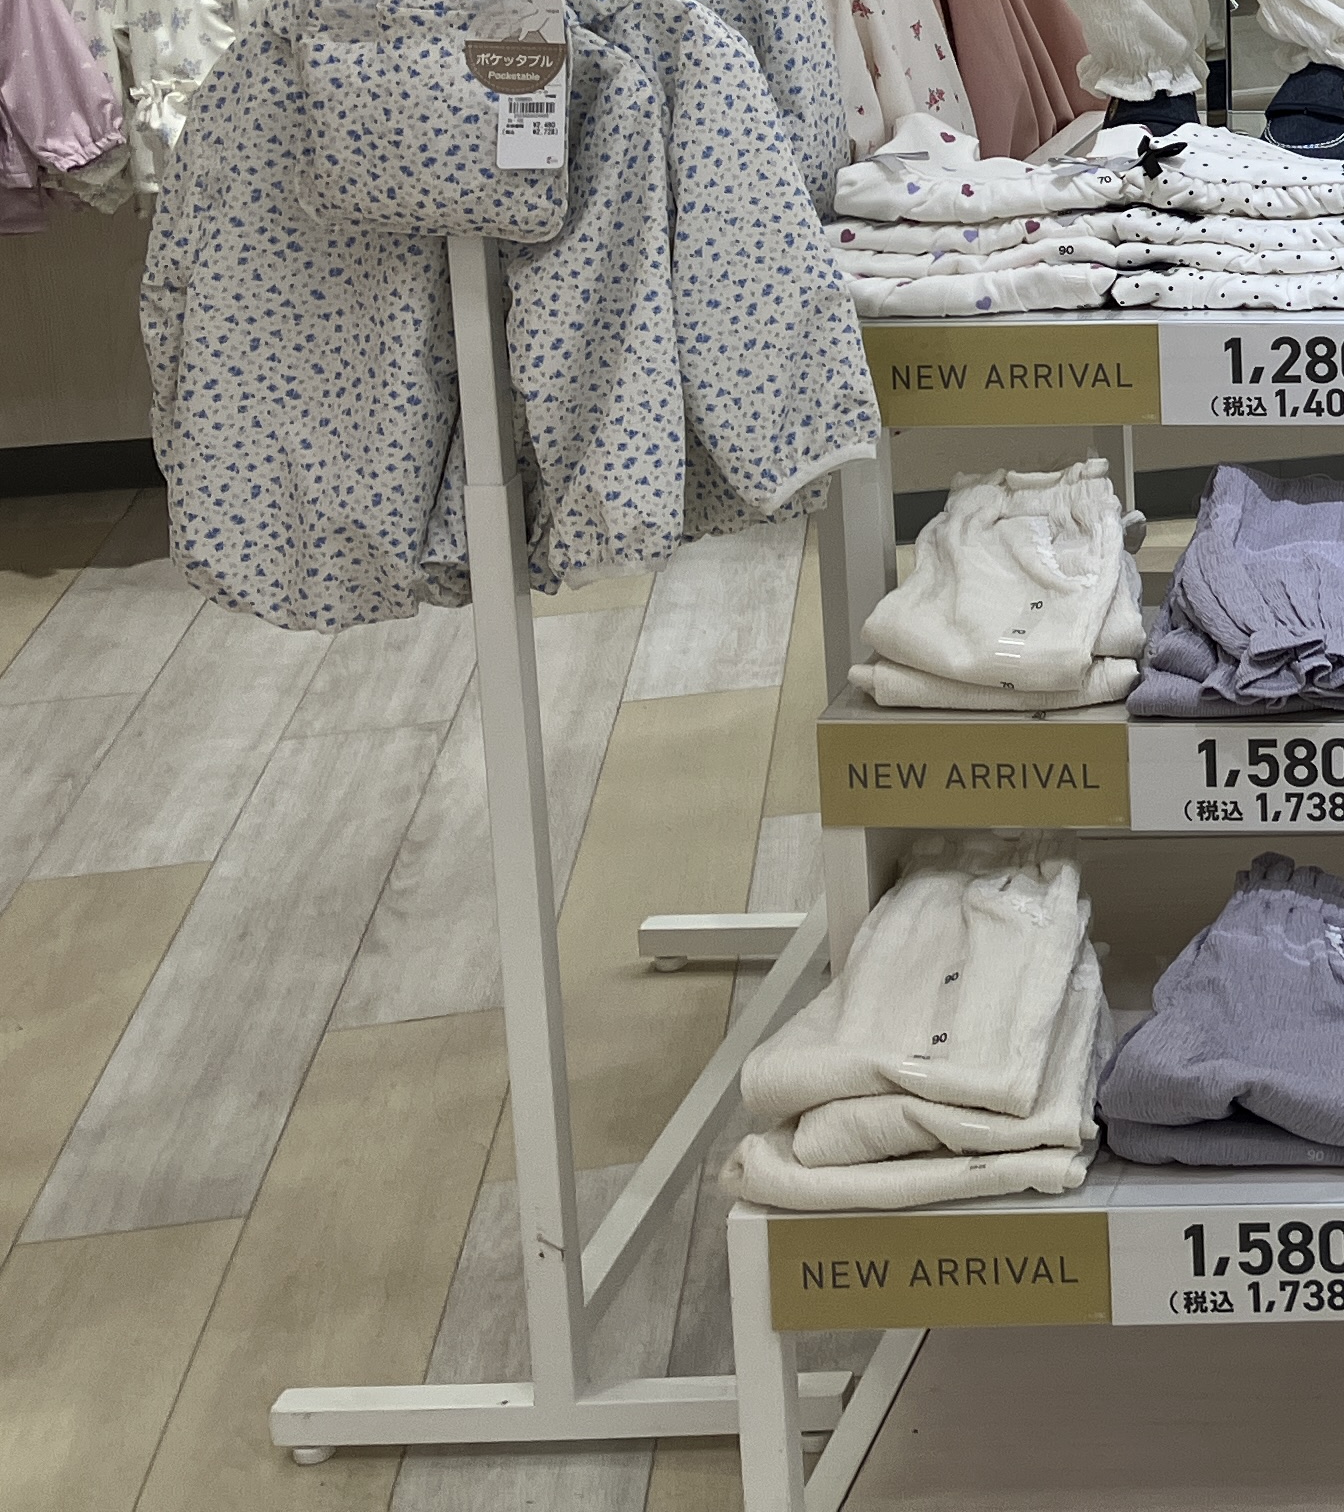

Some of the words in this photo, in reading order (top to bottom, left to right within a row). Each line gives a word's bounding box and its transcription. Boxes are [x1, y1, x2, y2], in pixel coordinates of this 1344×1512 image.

[476, 53, 554, 68] ポケッタブル
[488, 71, 541, 81] Pocketable
[1096, 175, 1111, 185] 70
[1058, 245, 1074, 256] 90
[892, 365, 967, 390] NEW
[985, 363, 1132, 389] ARRIVAL
[1030, 600, 1044, 610] 70
[849, 763, 926, 788] NEW
[946, 764, 1100, 789] ARRIVAL
[944, 971, 959, 985] 90
[932, 1032, 947, 1044] 90
[1307, 1150, 1324, 1161] 90
[803, 1260, 889, 1289] NEW
[909, 1256, 1078, 1287] ARRIVAL
